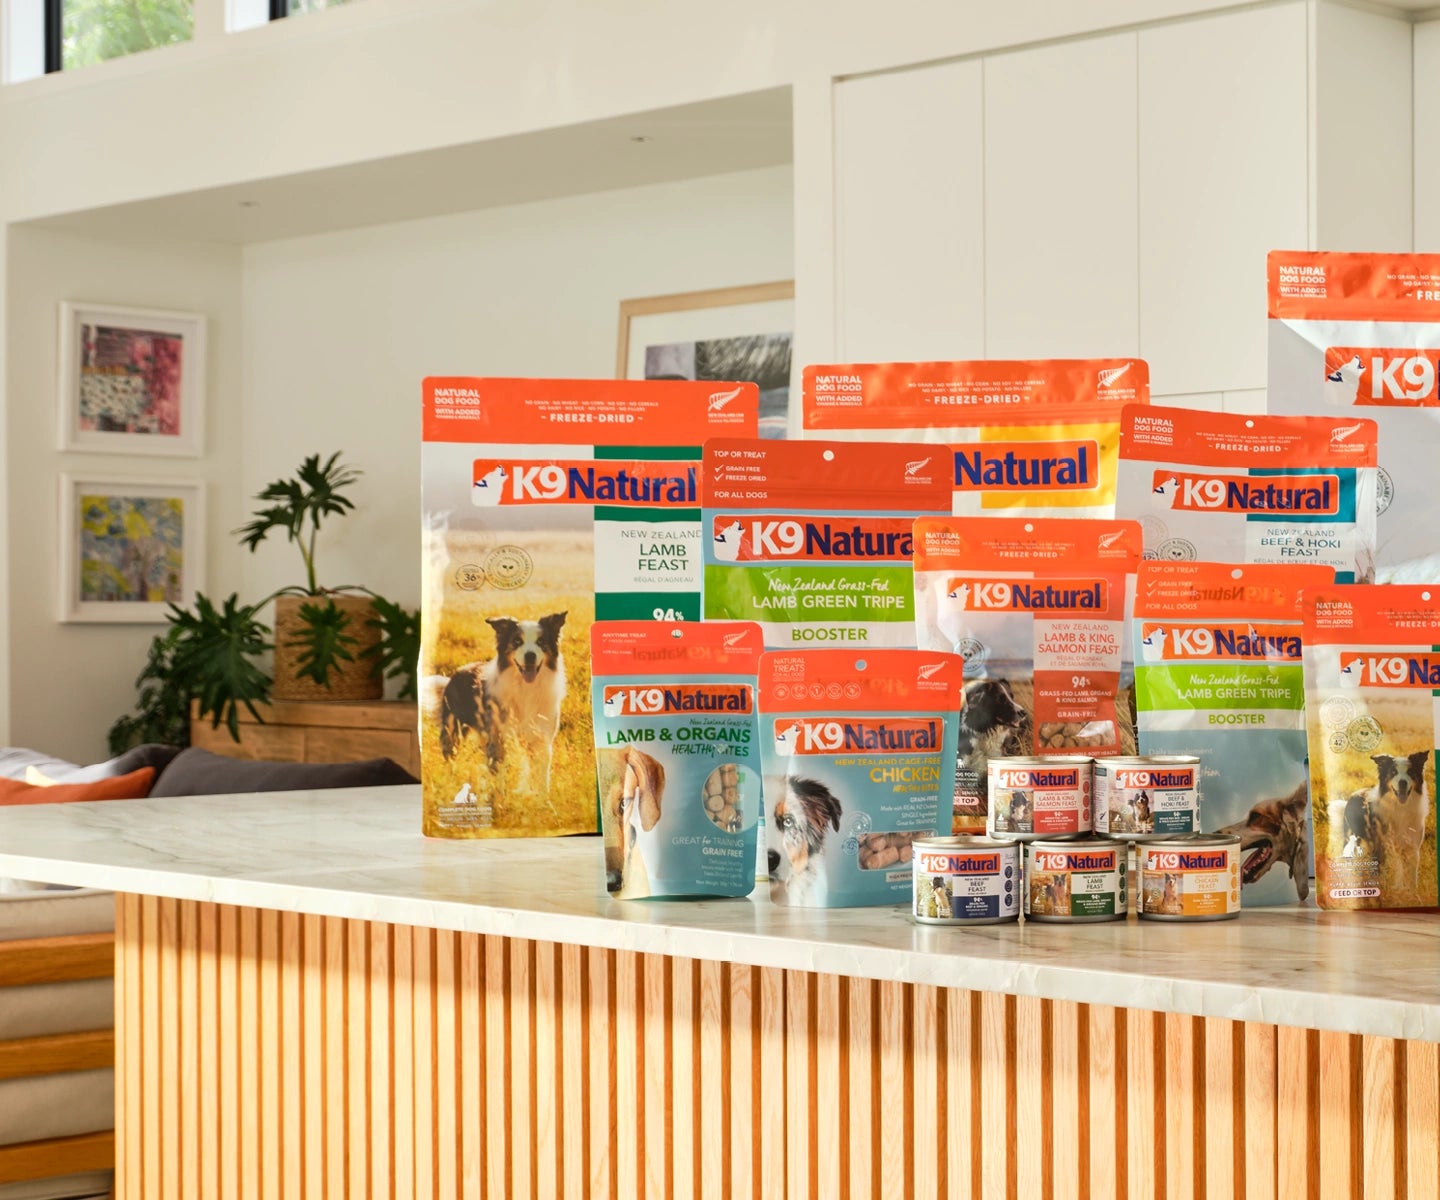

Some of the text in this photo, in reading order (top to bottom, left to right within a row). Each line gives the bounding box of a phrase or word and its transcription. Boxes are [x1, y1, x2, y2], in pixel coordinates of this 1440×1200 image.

[1280, 266, 1326, 276] NATURAL
[1280, 275, 1326, 284] DOG FOOD
[816, 375, 861, 384] NATURAL
[816, 384, 834, 392] DOG
[934, 394, 1020, 405] FREEZE-DRIED
[550, 414, 634, 423] FREEZE-DRIED
[1216, 444, 1281, 452] FREEZE-DRIED
[512, 465, 697, 502] K9Natural
[742, 491, 767, 499] DOGS
[1183, 479, 1329, 510] K9Natural
[751, 520, 914, 557] K9Natura
[1261, 538, 1341, 548] BEEF & HOKI
[640, 543, 686, 556] LAMB
[1281, 547, 1320, 557] FEAST
[638, 559, 689, 571] FEAST
[768, 578, 889, 591] New Zealand Grass-Fed
[753, 595, 905, 609] LAMB GREEN TRIPE
[974, 582, 1100, 609] K9Natural
[792, 628, 868, 641] BOOSTER
[1044, 633, 1114, 643] LAMB & KING
[1038, 644, 1120, 654] SALMON FEAST
[1171, 629, 1302, 656] K9Natura
[630, 687, 745, 712] K9Natural
[1177, 688, 1291, 699] LAMB GREEN TRIPE
[1209, 714, 1265, 724] BOOSTER
[607, 727, 751, 744] LAMB & ORGANS
[804, 722, 936, 750] K9Natural
[870, 767, 940, 782] CHICKEN
[1010, 771, 1076, 786] K9Natural
[1130, 771, 1192, 786] K9Natural
[930, 855, 997, 871] K9Natural
[1047, 854, 1113, 869] K9Natural
[1160, 853, 1225, 869] K9Natural
